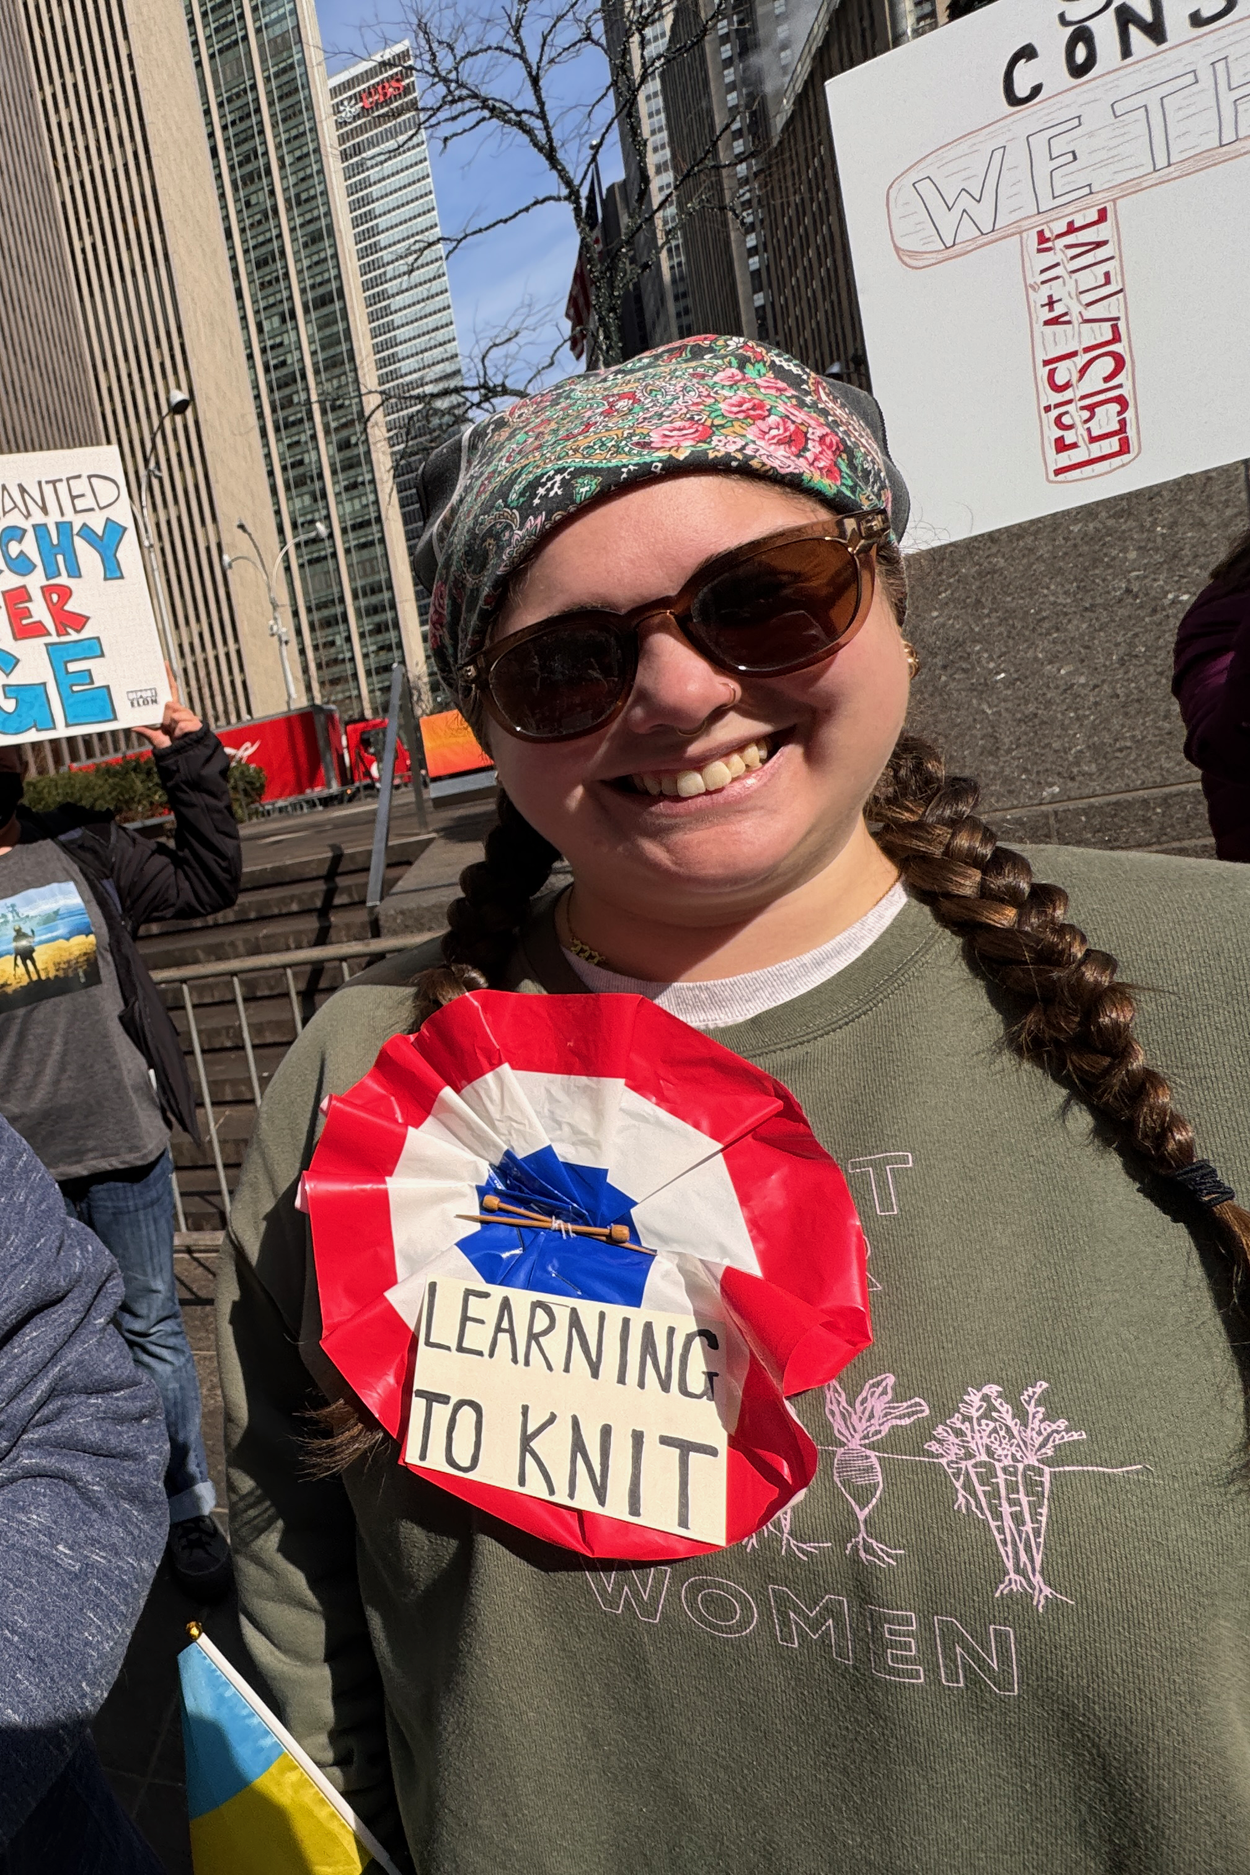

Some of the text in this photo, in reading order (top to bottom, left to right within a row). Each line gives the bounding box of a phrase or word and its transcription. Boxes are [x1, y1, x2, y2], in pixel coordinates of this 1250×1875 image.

[361, 75, 404, 109] UBS
[913, 115, 1094, 249] WE
[423, 1280, 719, 1401] LEARNING
[414, 1389, 719, 1530] TO KNIT
[585, 1559, 1018, 1696] WOMEN
